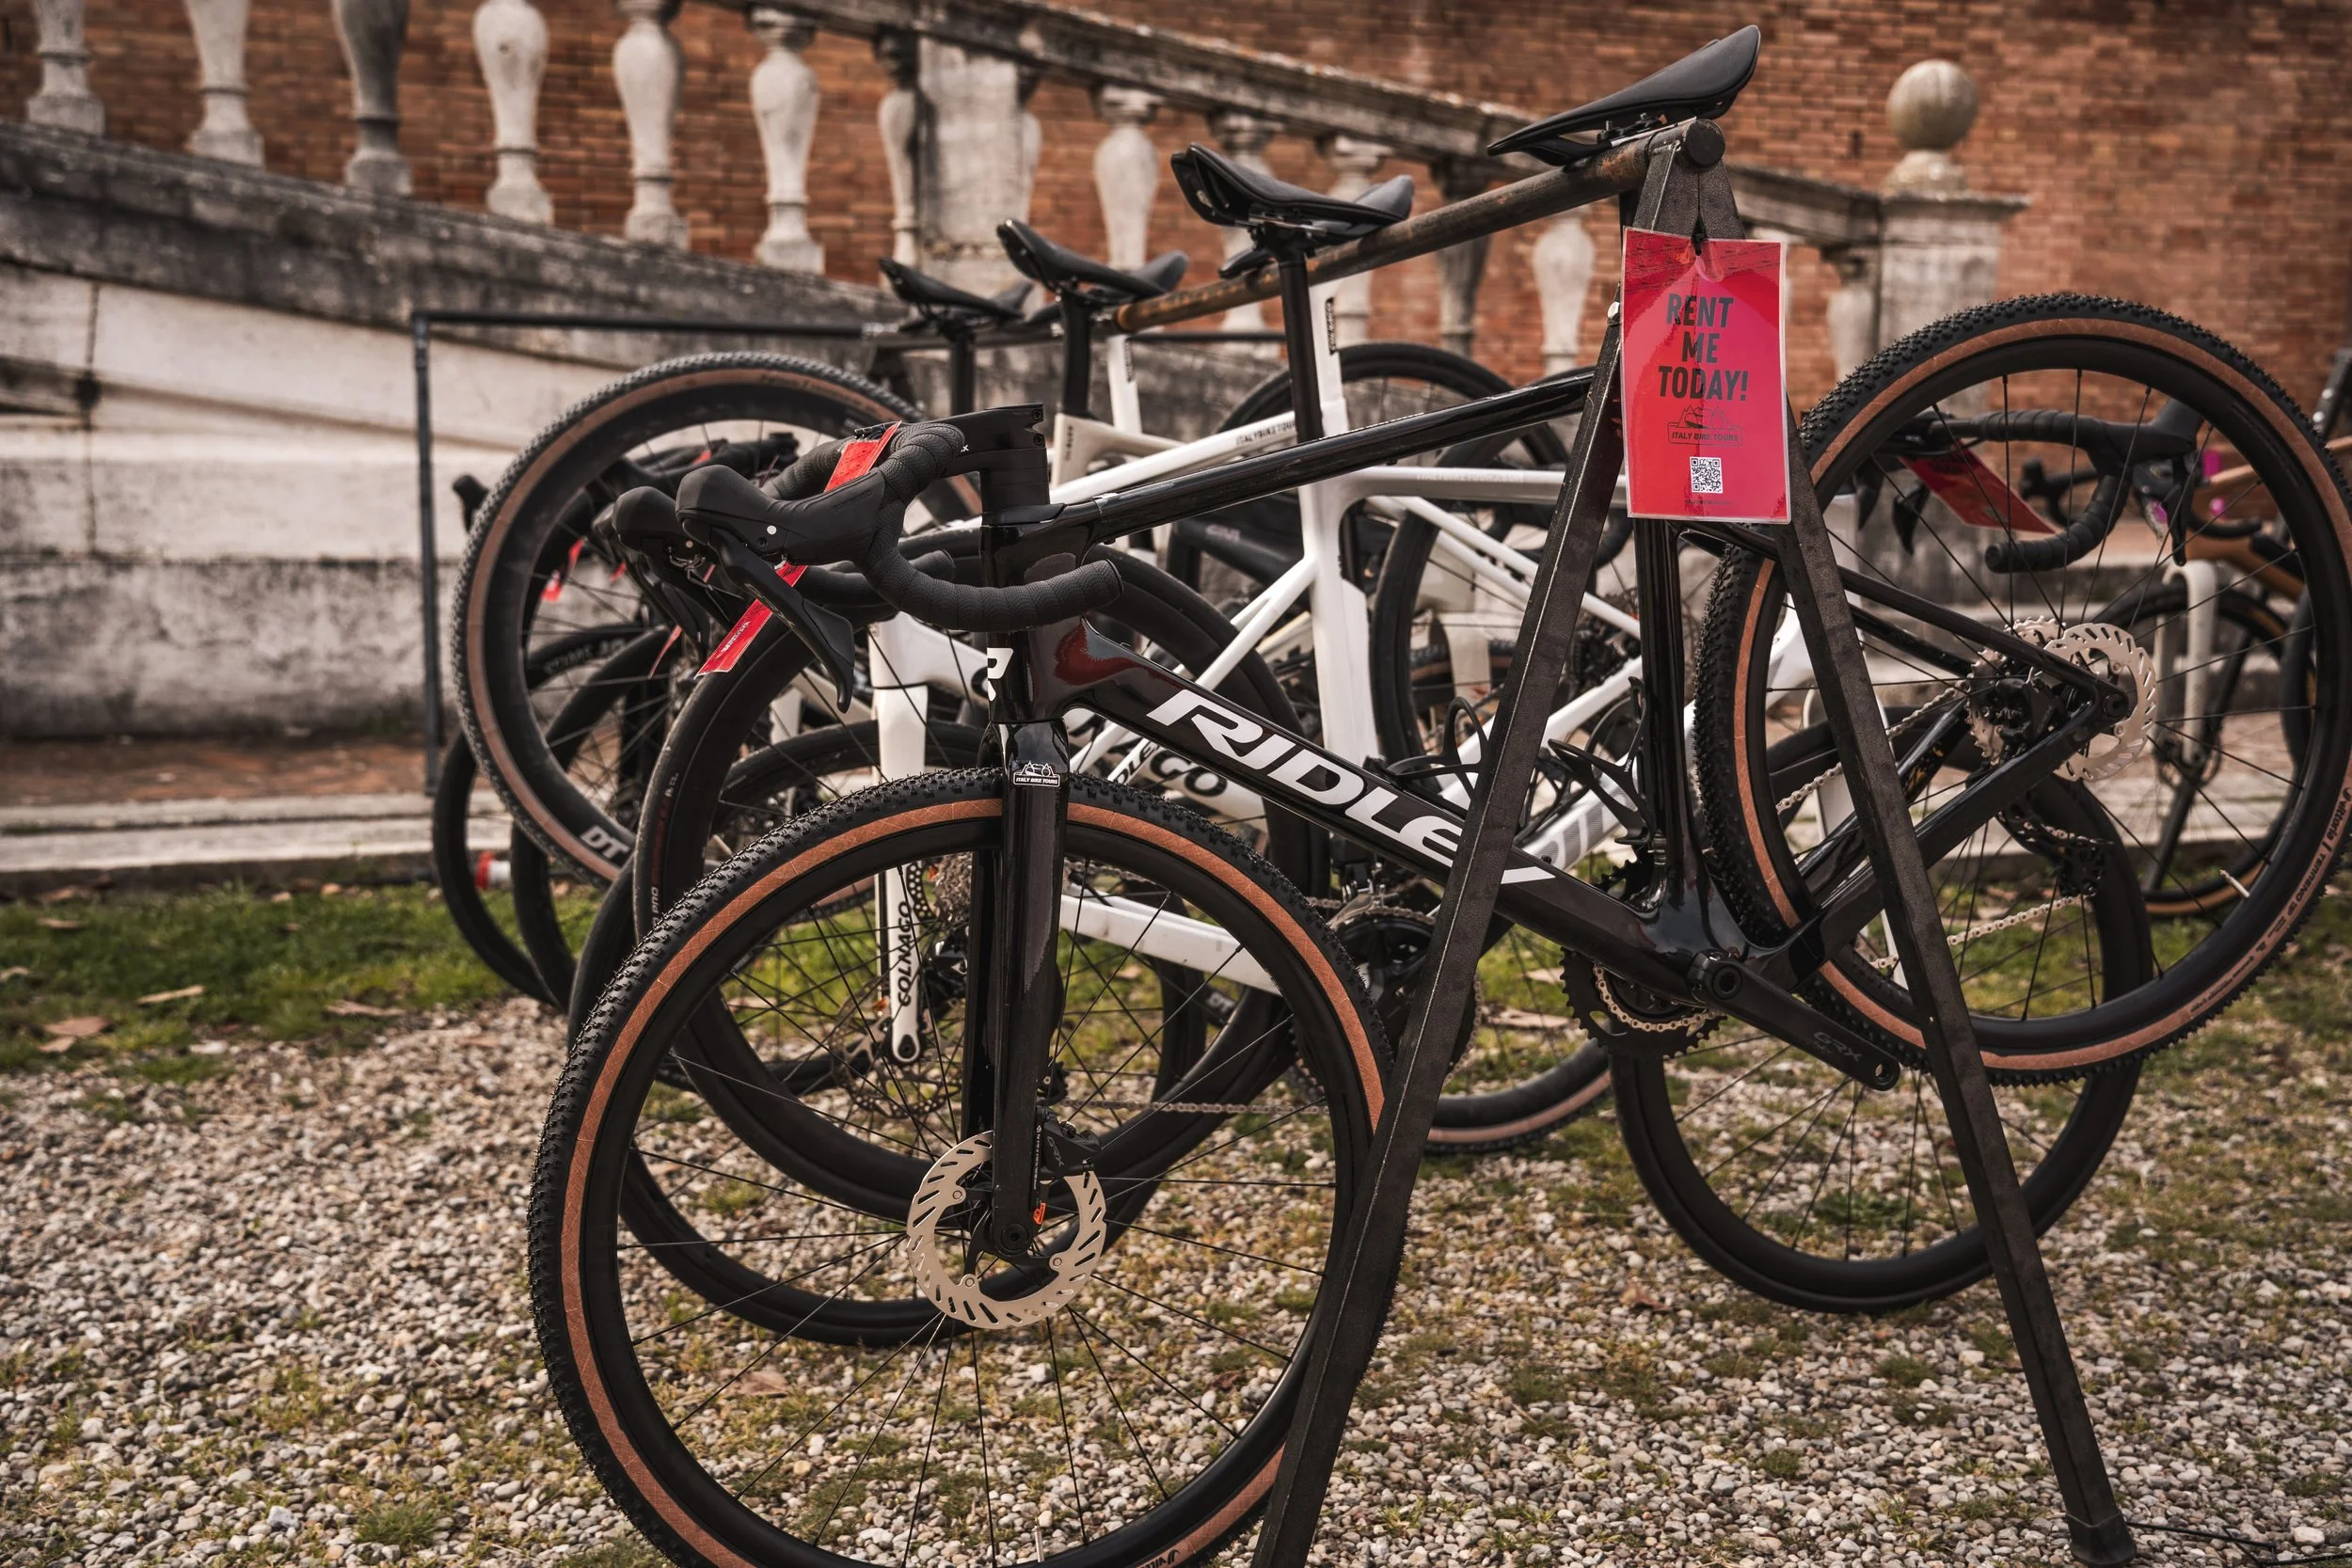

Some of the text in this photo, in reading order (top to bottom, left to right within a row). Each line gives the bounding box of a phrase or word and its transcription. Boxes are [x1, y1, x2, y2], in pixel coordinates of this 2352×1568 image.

[1666, 293, 1734, 328] RENT
[1681, 331, 1719, 363] ME
[1658, 366, 1749, 402] TODAY!
[1672, 432, 1692, 440] ITALY
[1693, 433, 1711, 441] BIKE
[1147, 689, 1556, 885] RIDLE
[2327, 801, 2348, 840] vittoria
[580, 825, 631, 859] DT
[898, 900, 913, 1007] COLNAGO
[1813, 1031, 1862, 1063] GRX
[1046, 1135, 1065, 1167] GRX
